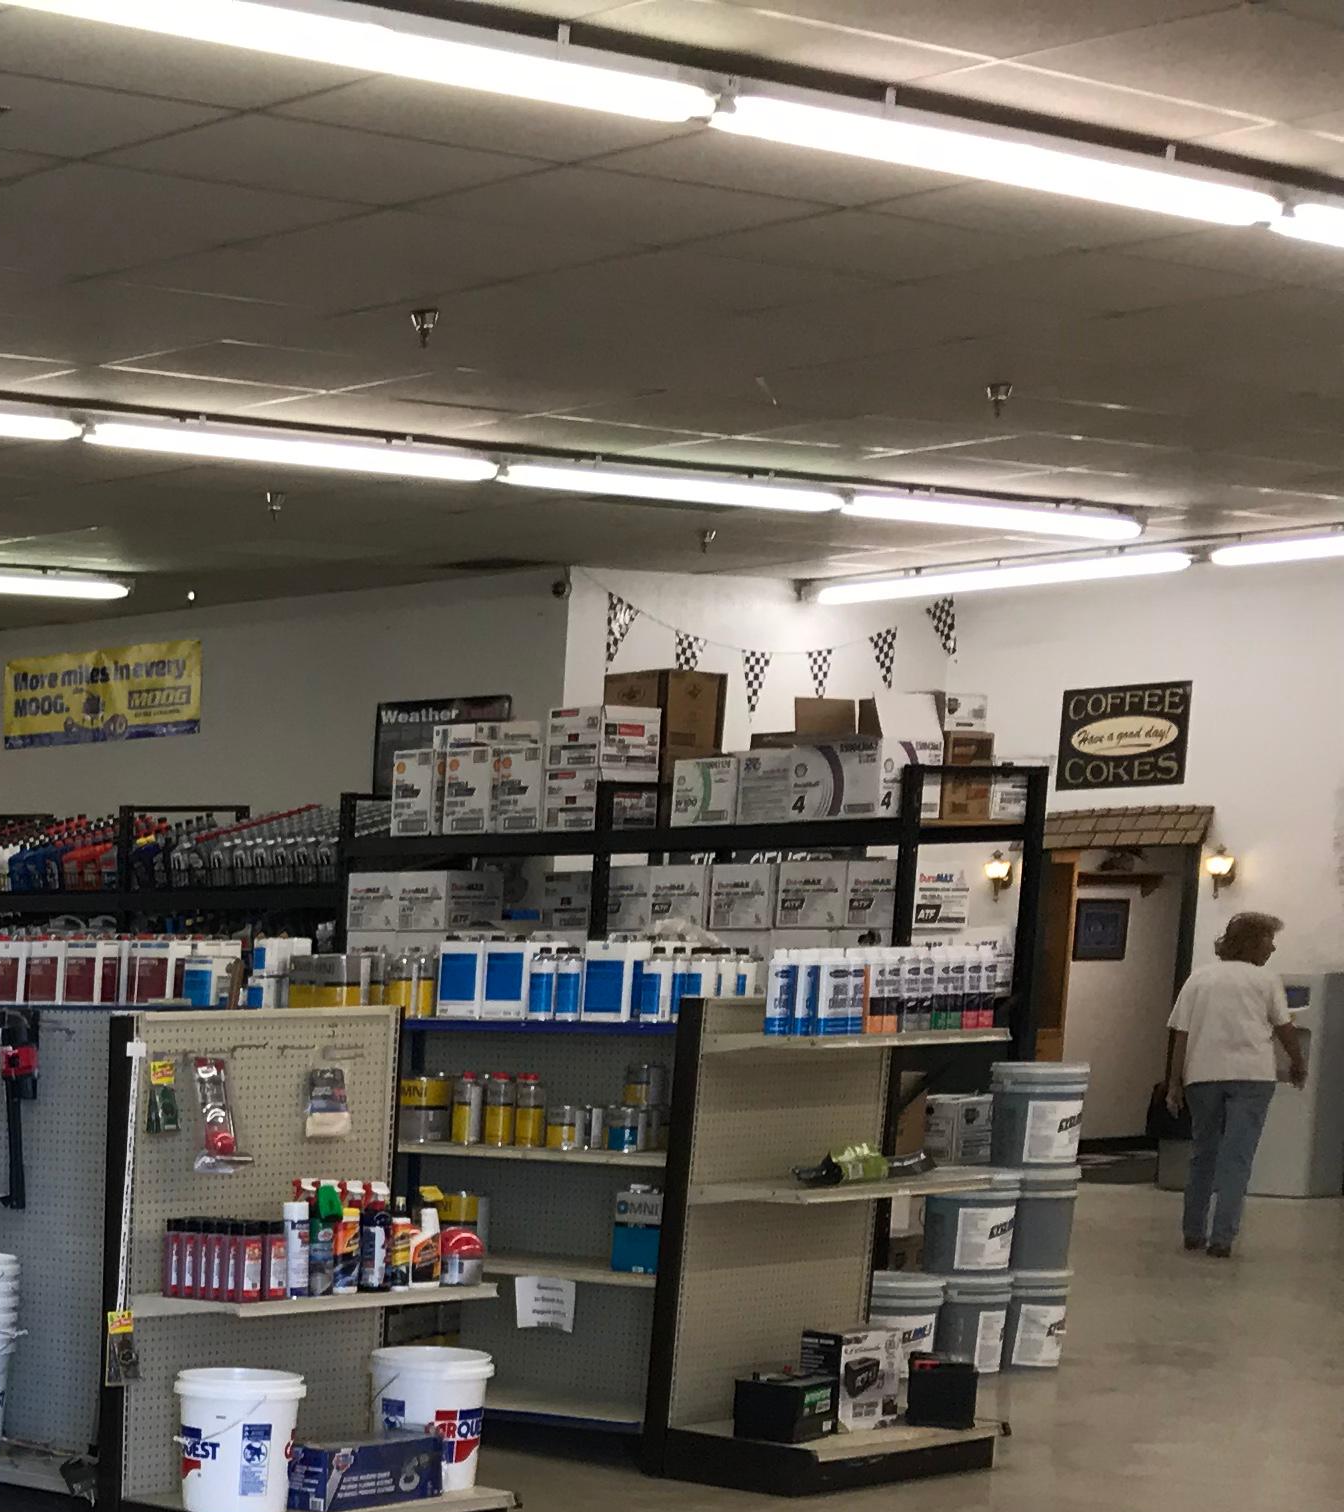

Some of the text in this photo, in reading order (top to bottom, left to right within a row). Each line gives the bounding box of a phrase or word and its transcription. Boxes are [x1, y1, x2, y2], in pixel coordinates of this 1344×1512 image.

[14, 671, 58, 692] More
[61, 664, 109, 687] miles
[1069, 687, 1184, 720] COFFEE
[381, 707, 459, 725] Weather
[1077, 725, 1172, 747] Have a good day!
[1065, 753, 1178, 784] COKES
[792, 795, 806, 814] 4
[881, 791, 892, 810] 4
[917, 908, 938, 921] ATF
[617, 1200, 660, 1216] OMNI
